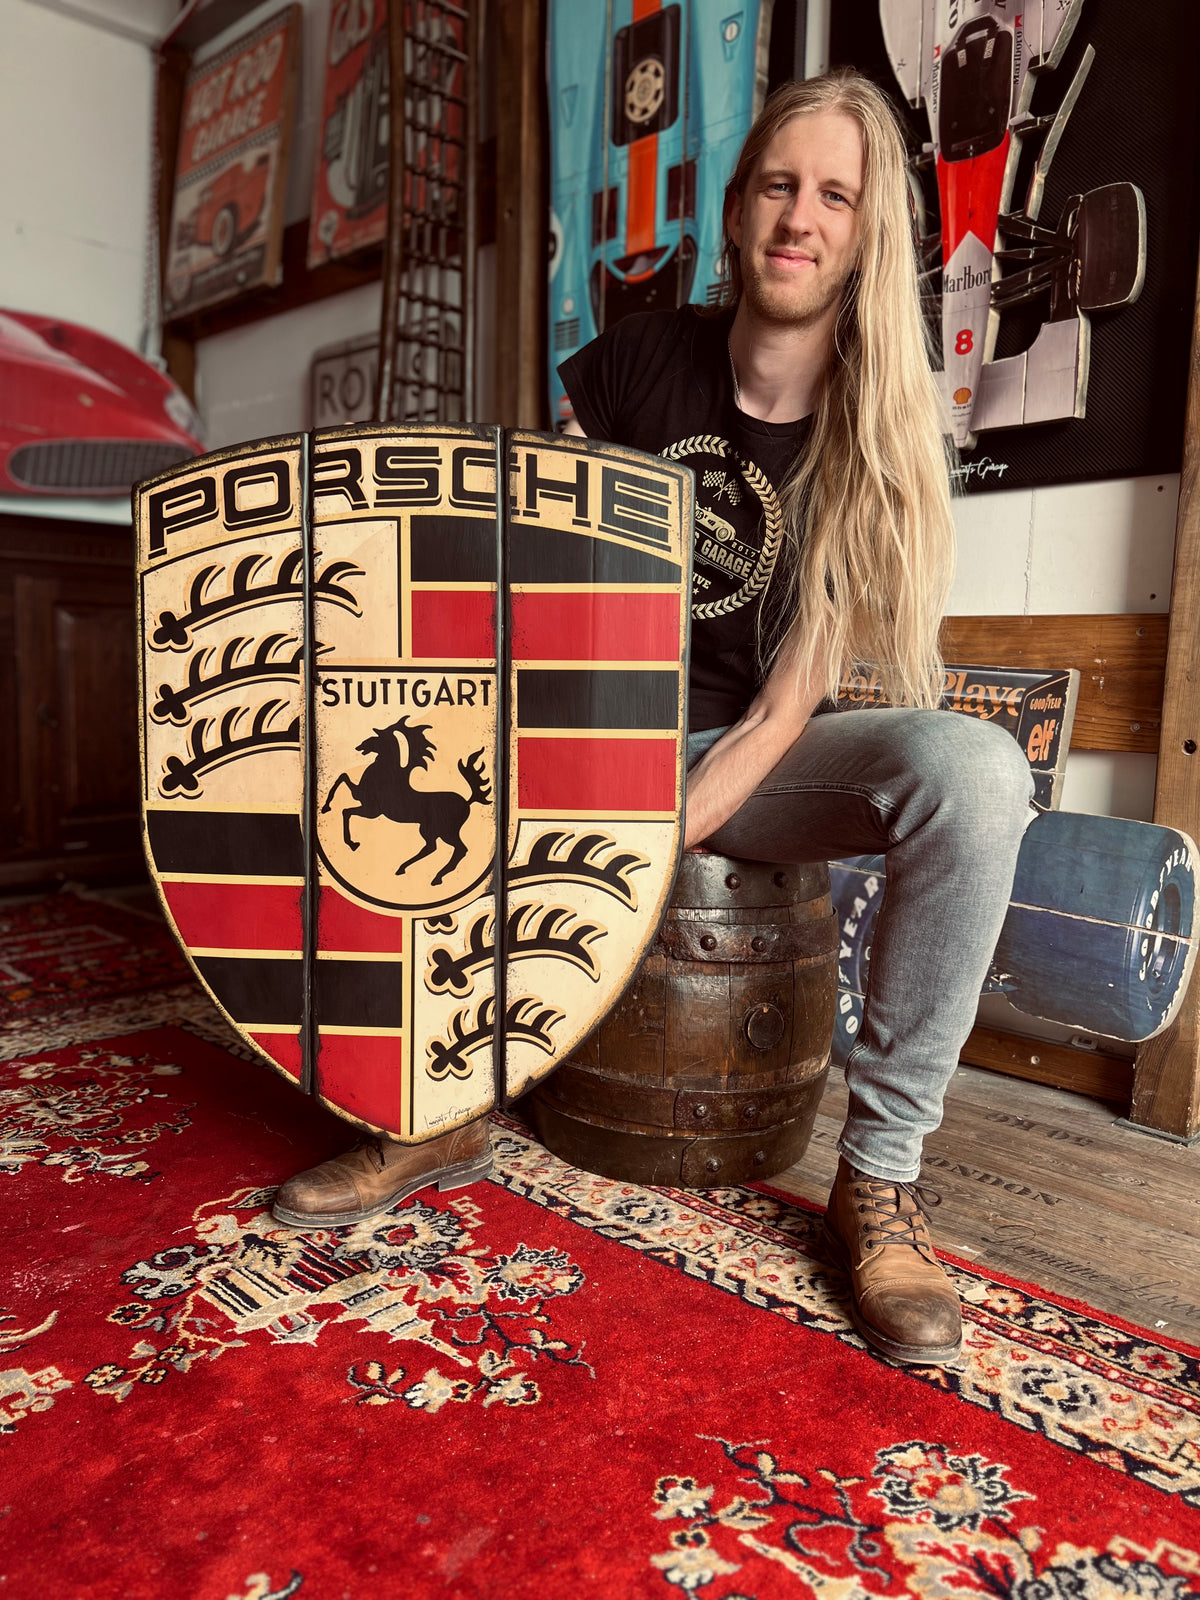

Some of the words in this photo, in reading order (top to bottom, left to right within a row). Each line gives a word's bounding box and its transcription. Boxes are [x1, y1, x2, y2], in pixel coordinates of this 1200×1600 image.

[1013, 31, 1023, 85] Marlboro
[931, 60, 941, 114] Marlboro
[955, 329, 973, 356] 8
[148, 446, 672, 560] PORSCHE
[701, 539, 752, 578] GARAGE
[731, 541, 756, 558] 2017
[322, 676, 492, 708] STUTTGART
[1027, 719, 1056, 762] elf
